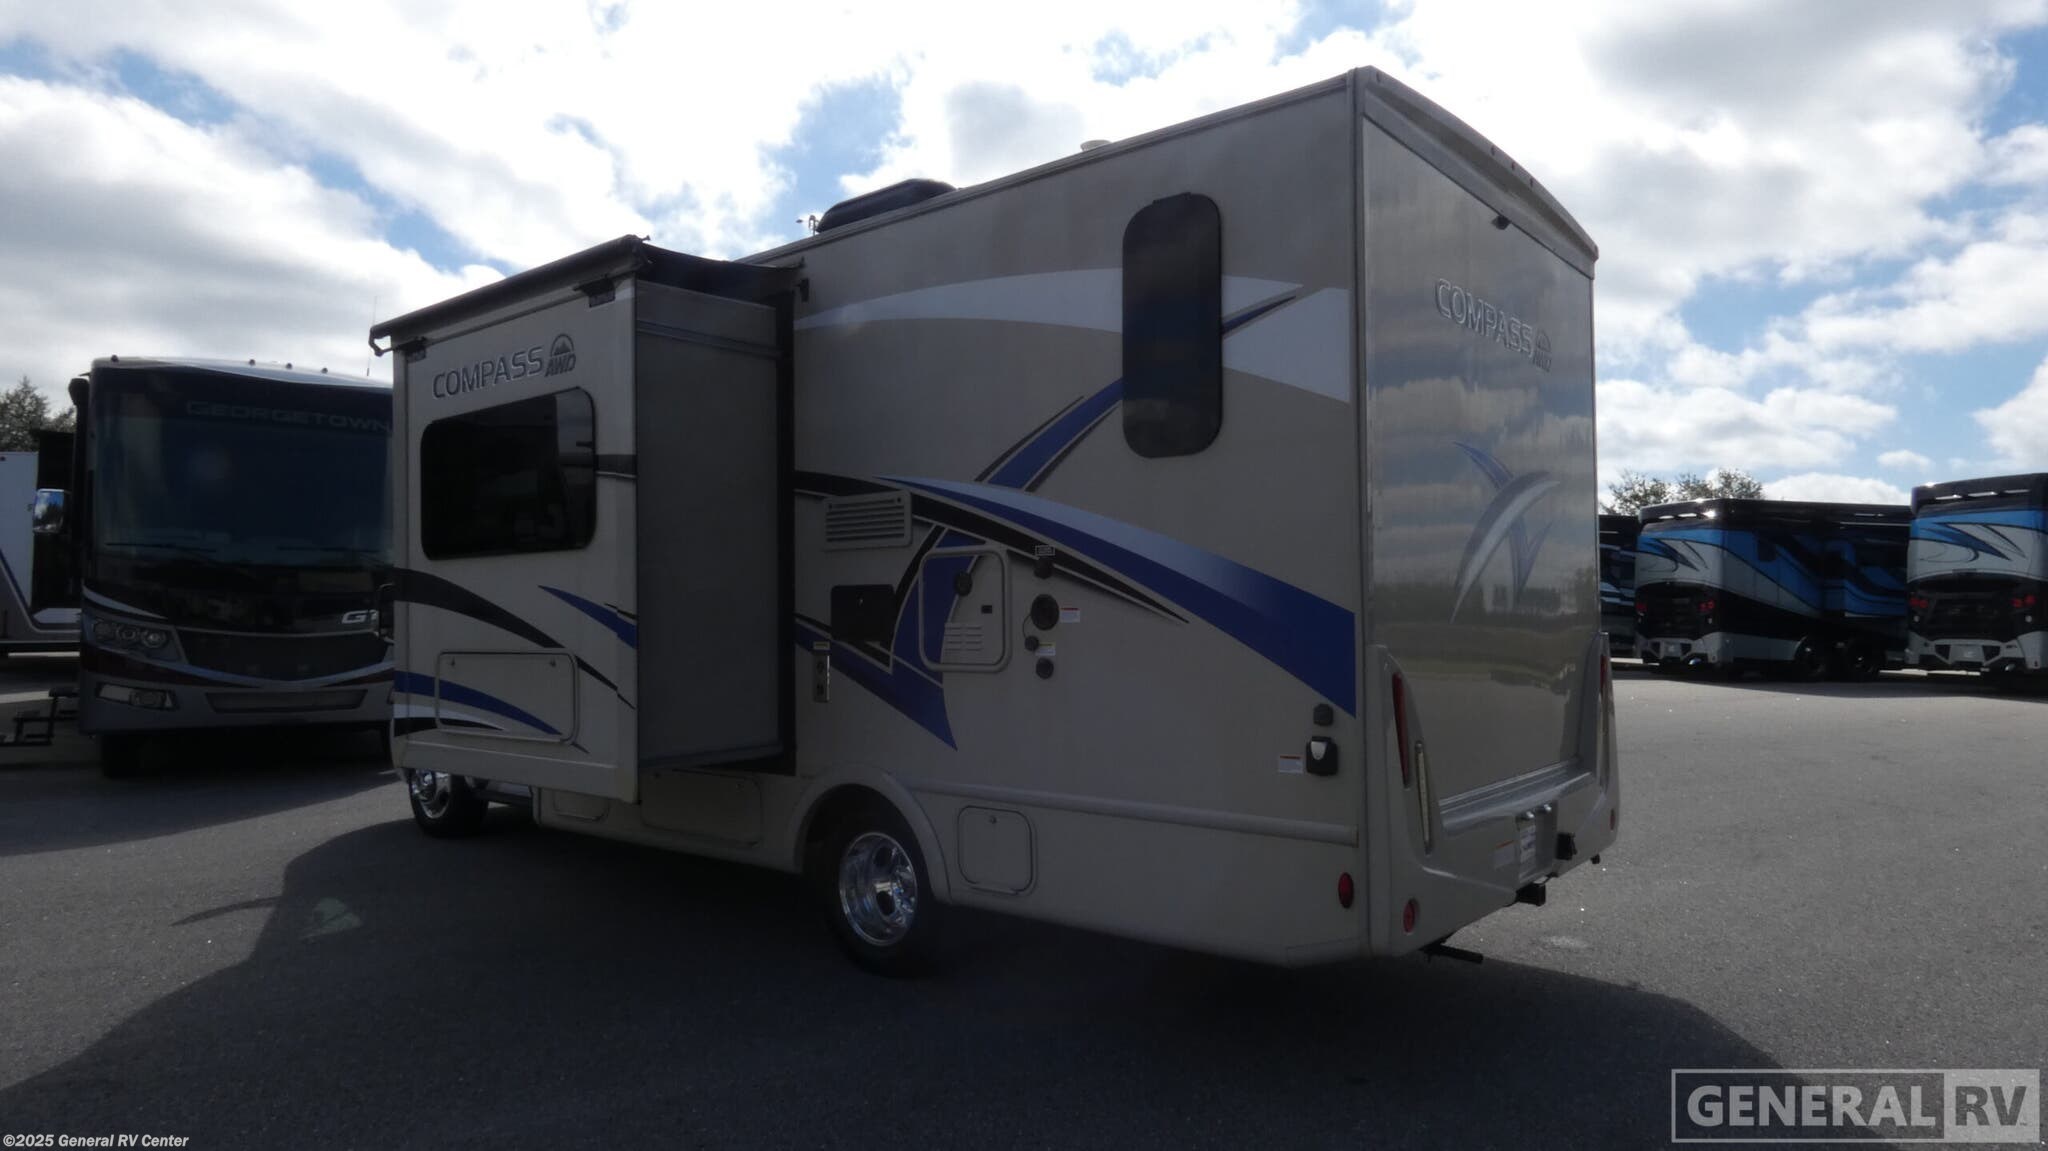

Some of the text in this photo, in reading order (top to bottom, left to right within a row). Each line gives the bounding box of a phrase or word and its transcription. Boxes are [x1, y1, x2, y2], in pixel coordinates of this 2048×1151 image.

[1434, 278, 1535, 358] COMPASS
[432, 346, 544, 400] COMPASS
[544, 353, 577, 378] AWD
[186, 400, 391, 434] GEORGETOWN
